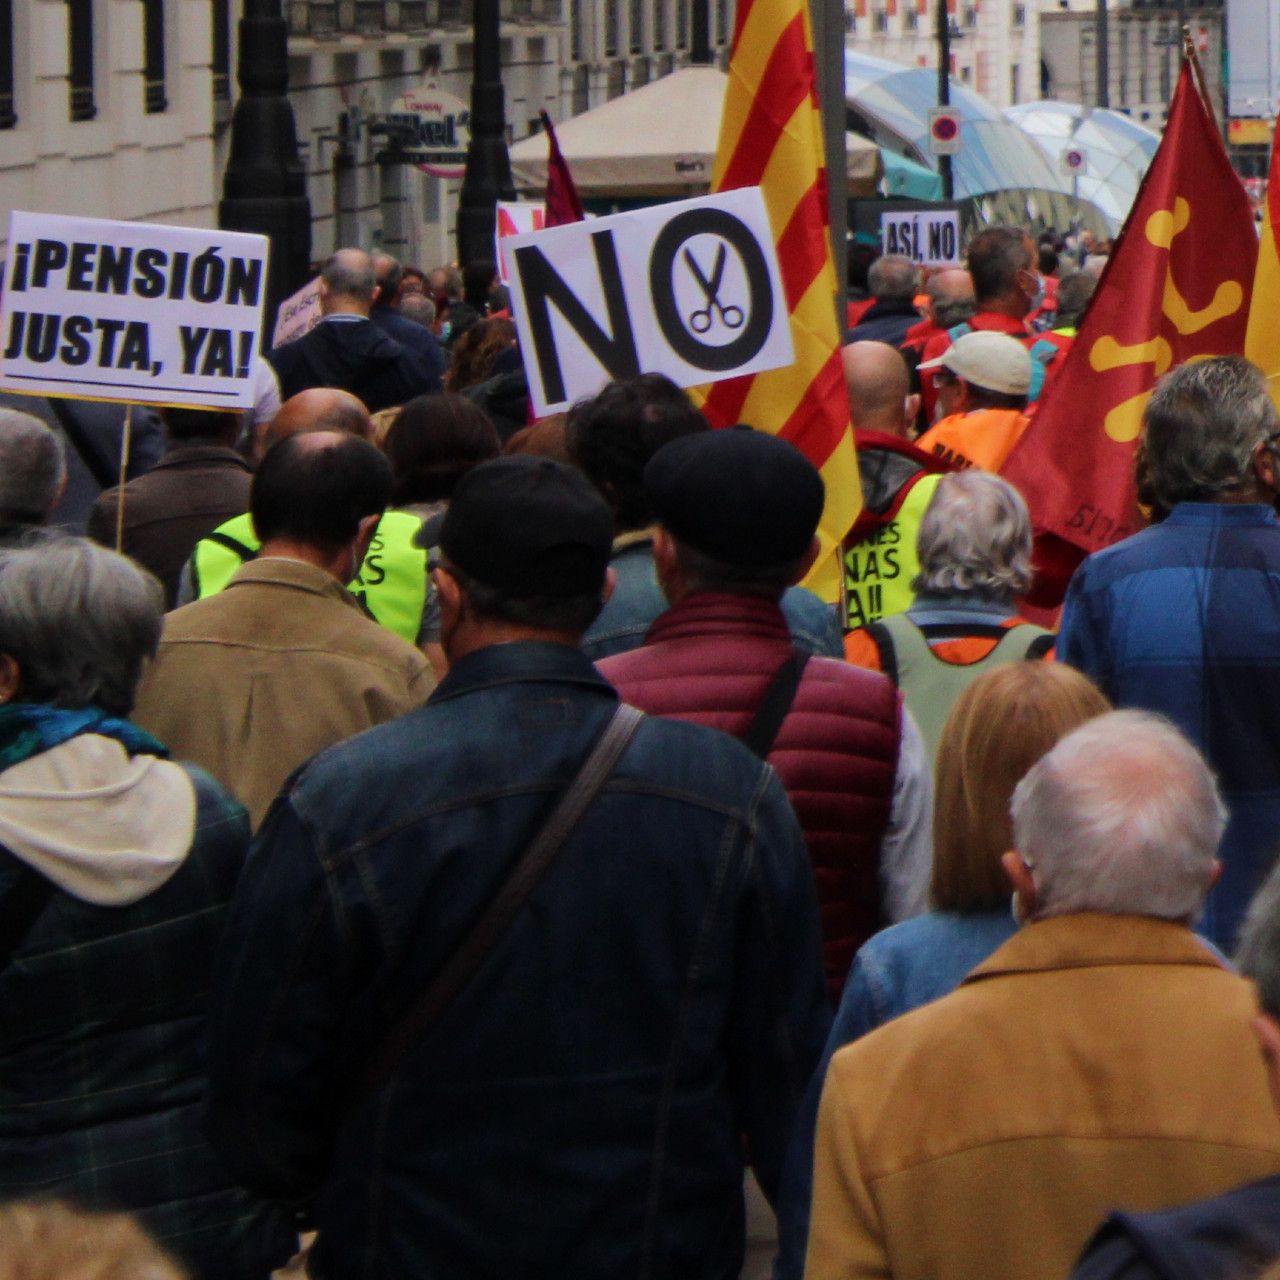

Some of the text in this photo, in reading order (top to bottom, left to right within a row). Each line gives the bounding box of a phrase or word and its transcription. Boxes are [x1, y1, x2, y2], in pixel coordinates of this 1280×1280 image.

[10, 238, 263, 307] ¡PENSIÓN
[929, 220, 956, 260] NO
[514, 206, 775, 407] NO
[4, 310, 255, 379] JUSTA, YA!
